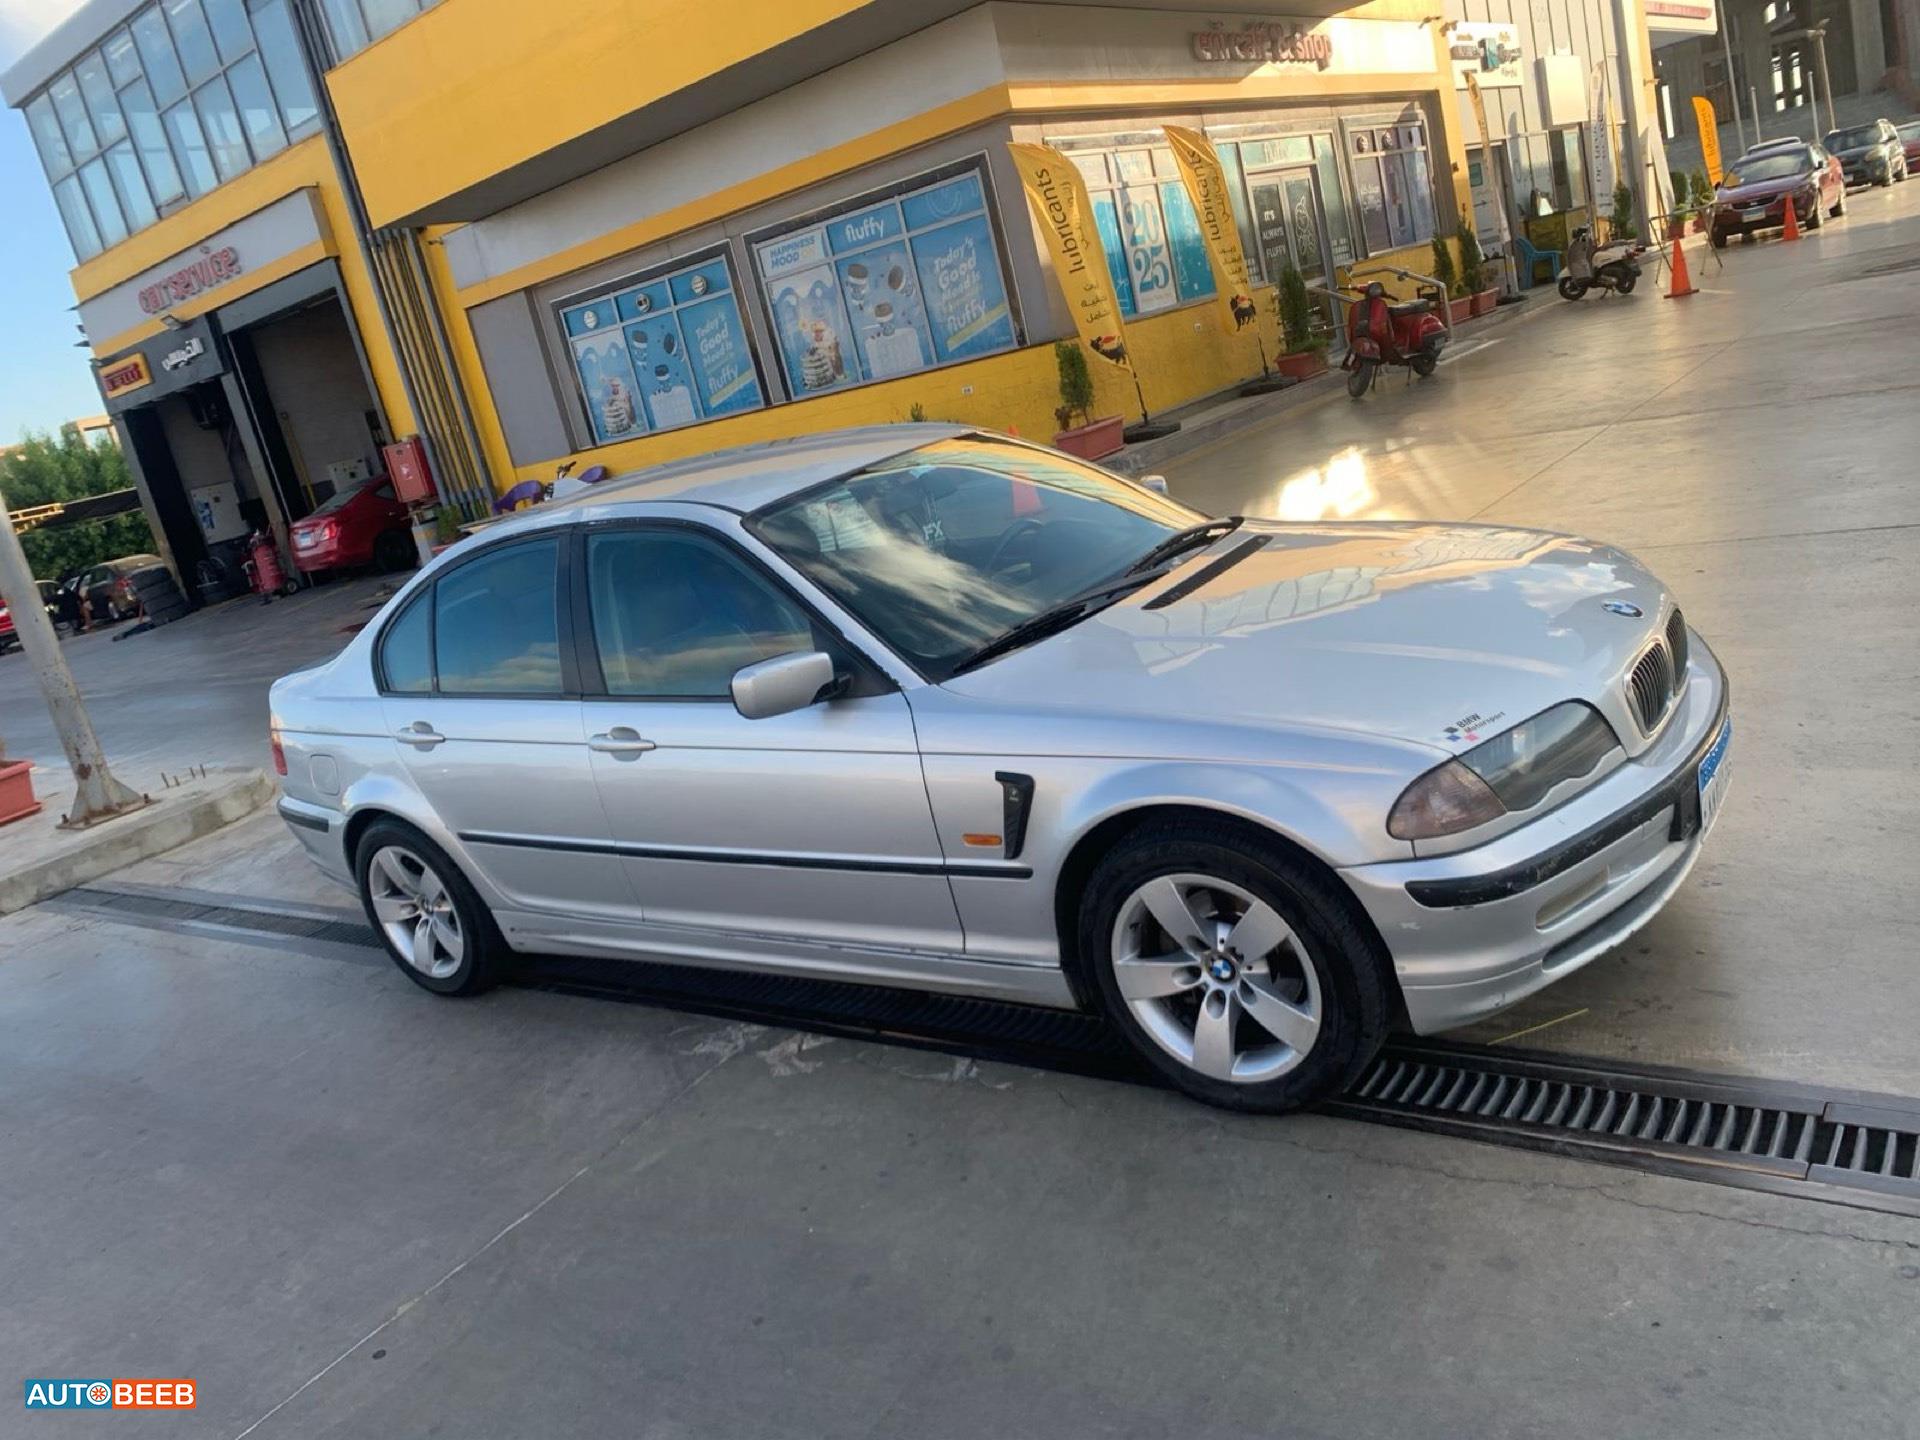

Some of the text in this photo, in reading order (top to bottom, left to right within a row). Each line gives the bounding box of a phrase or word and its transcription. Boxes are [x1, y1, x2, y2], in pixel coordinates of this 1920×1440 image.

[1187, 150, 1222, 241] lubricants
[844, 216, 884, 243] fluffy
[1036, 167, 1085, 274] lubricants
[1262, 227, 1285, 241] ALWAYS
[769, 234, 816, 258] HAPPINESS
[771, 250, 800, 269] MOOD
[934, 236, 975, 273] Today's
[1266, 244, 1288, 259] FLUFFY
[939, 247, 978, 289] Good
[947, 299, 987, 335] fluffy
[700, 321, 730, 355] Good
[707, 364, 739, 394] fluffy
[1456, 713, 1481, 728] BMW
